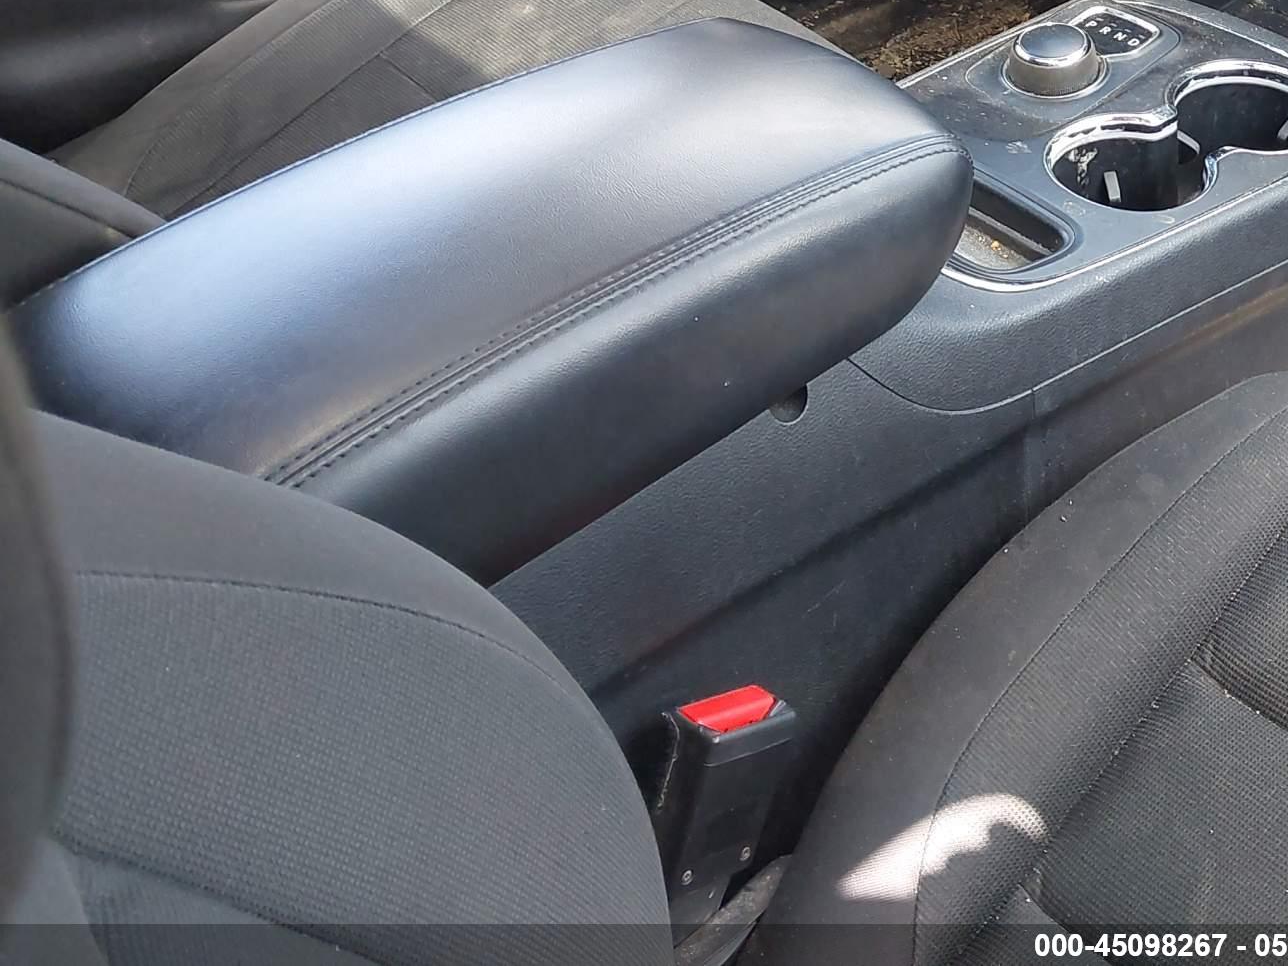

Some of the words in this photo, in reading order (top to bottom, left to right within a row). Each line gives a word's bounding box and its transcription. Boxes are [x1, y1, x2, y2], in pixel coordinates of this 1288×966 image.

[1099, 26, 1112, 35] R
[1113, 32, 1128, 41] N
[1127, 38, 1140, 46] D
